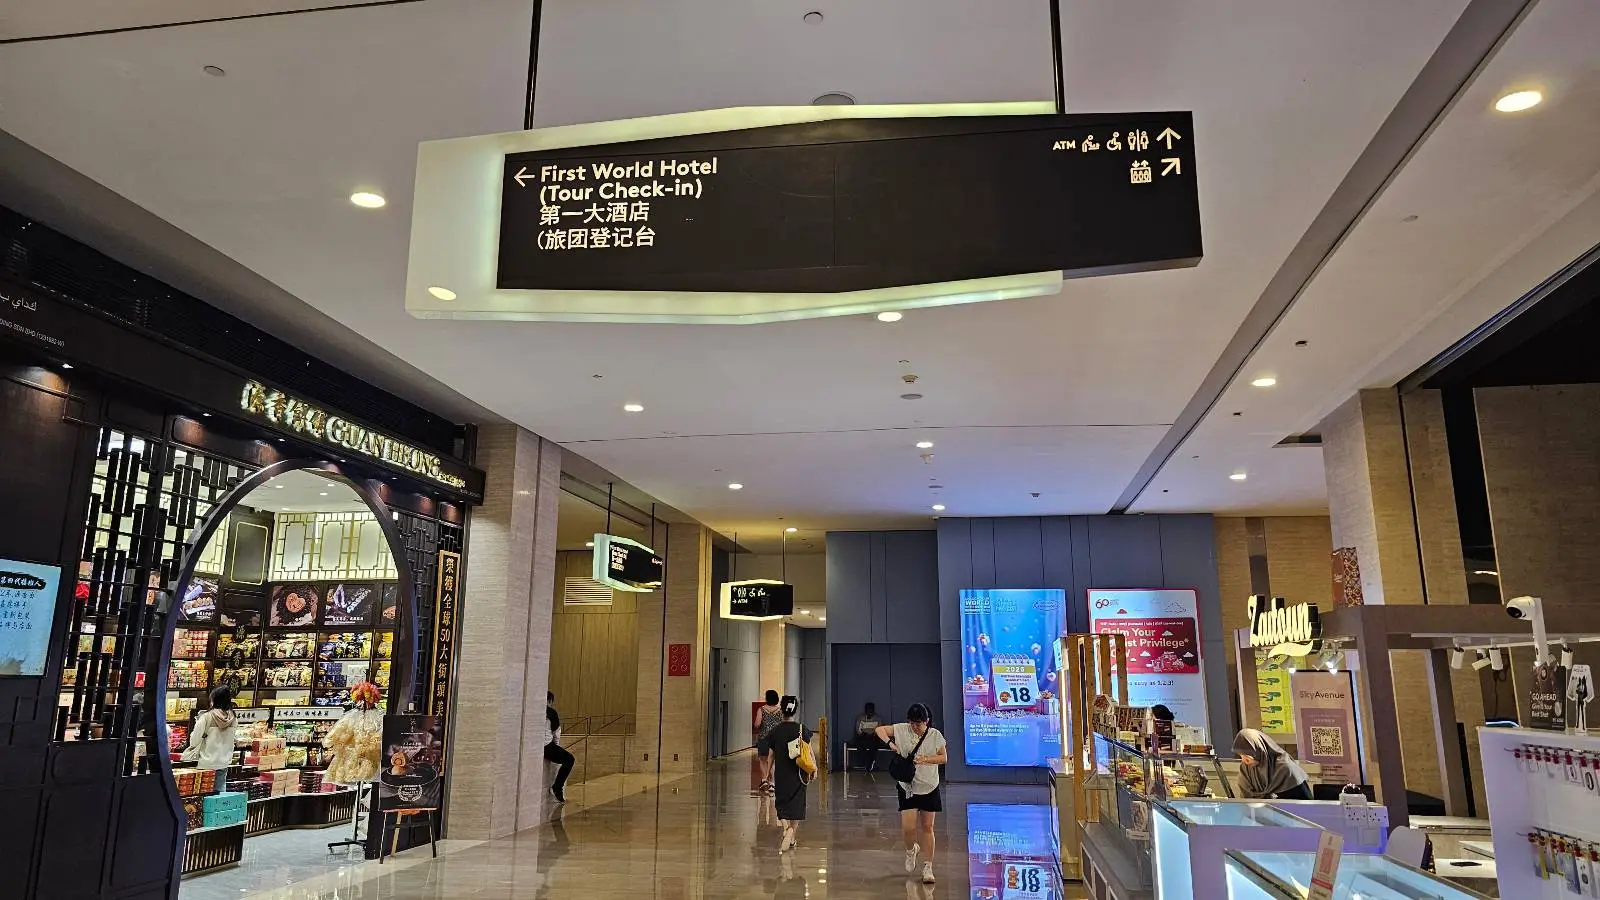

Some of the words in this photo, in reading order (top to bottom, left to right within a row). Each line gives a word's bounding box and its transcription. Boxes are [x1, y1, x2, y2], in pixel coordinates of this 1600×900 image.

[1053, 140, 1076, 150] ATM
[541, 165, 586, 182] First
[592, 161, 653, 180] World
[661, 157, 718, 176] Hotel
[539, 184, 593, 206] (Tour
[599, 178, 702, 199] Check-in)
[539, 201, 650, 225] 第一大酒店
[537, 225, 656, 250] (旅团登记台
[326, 416, 385, 458] GUAN
[1131, 628, 1155, 637] Your
[1010, 687, 1031, 702] 18
[1300, 690, 1345, 699] SkyAvenue
